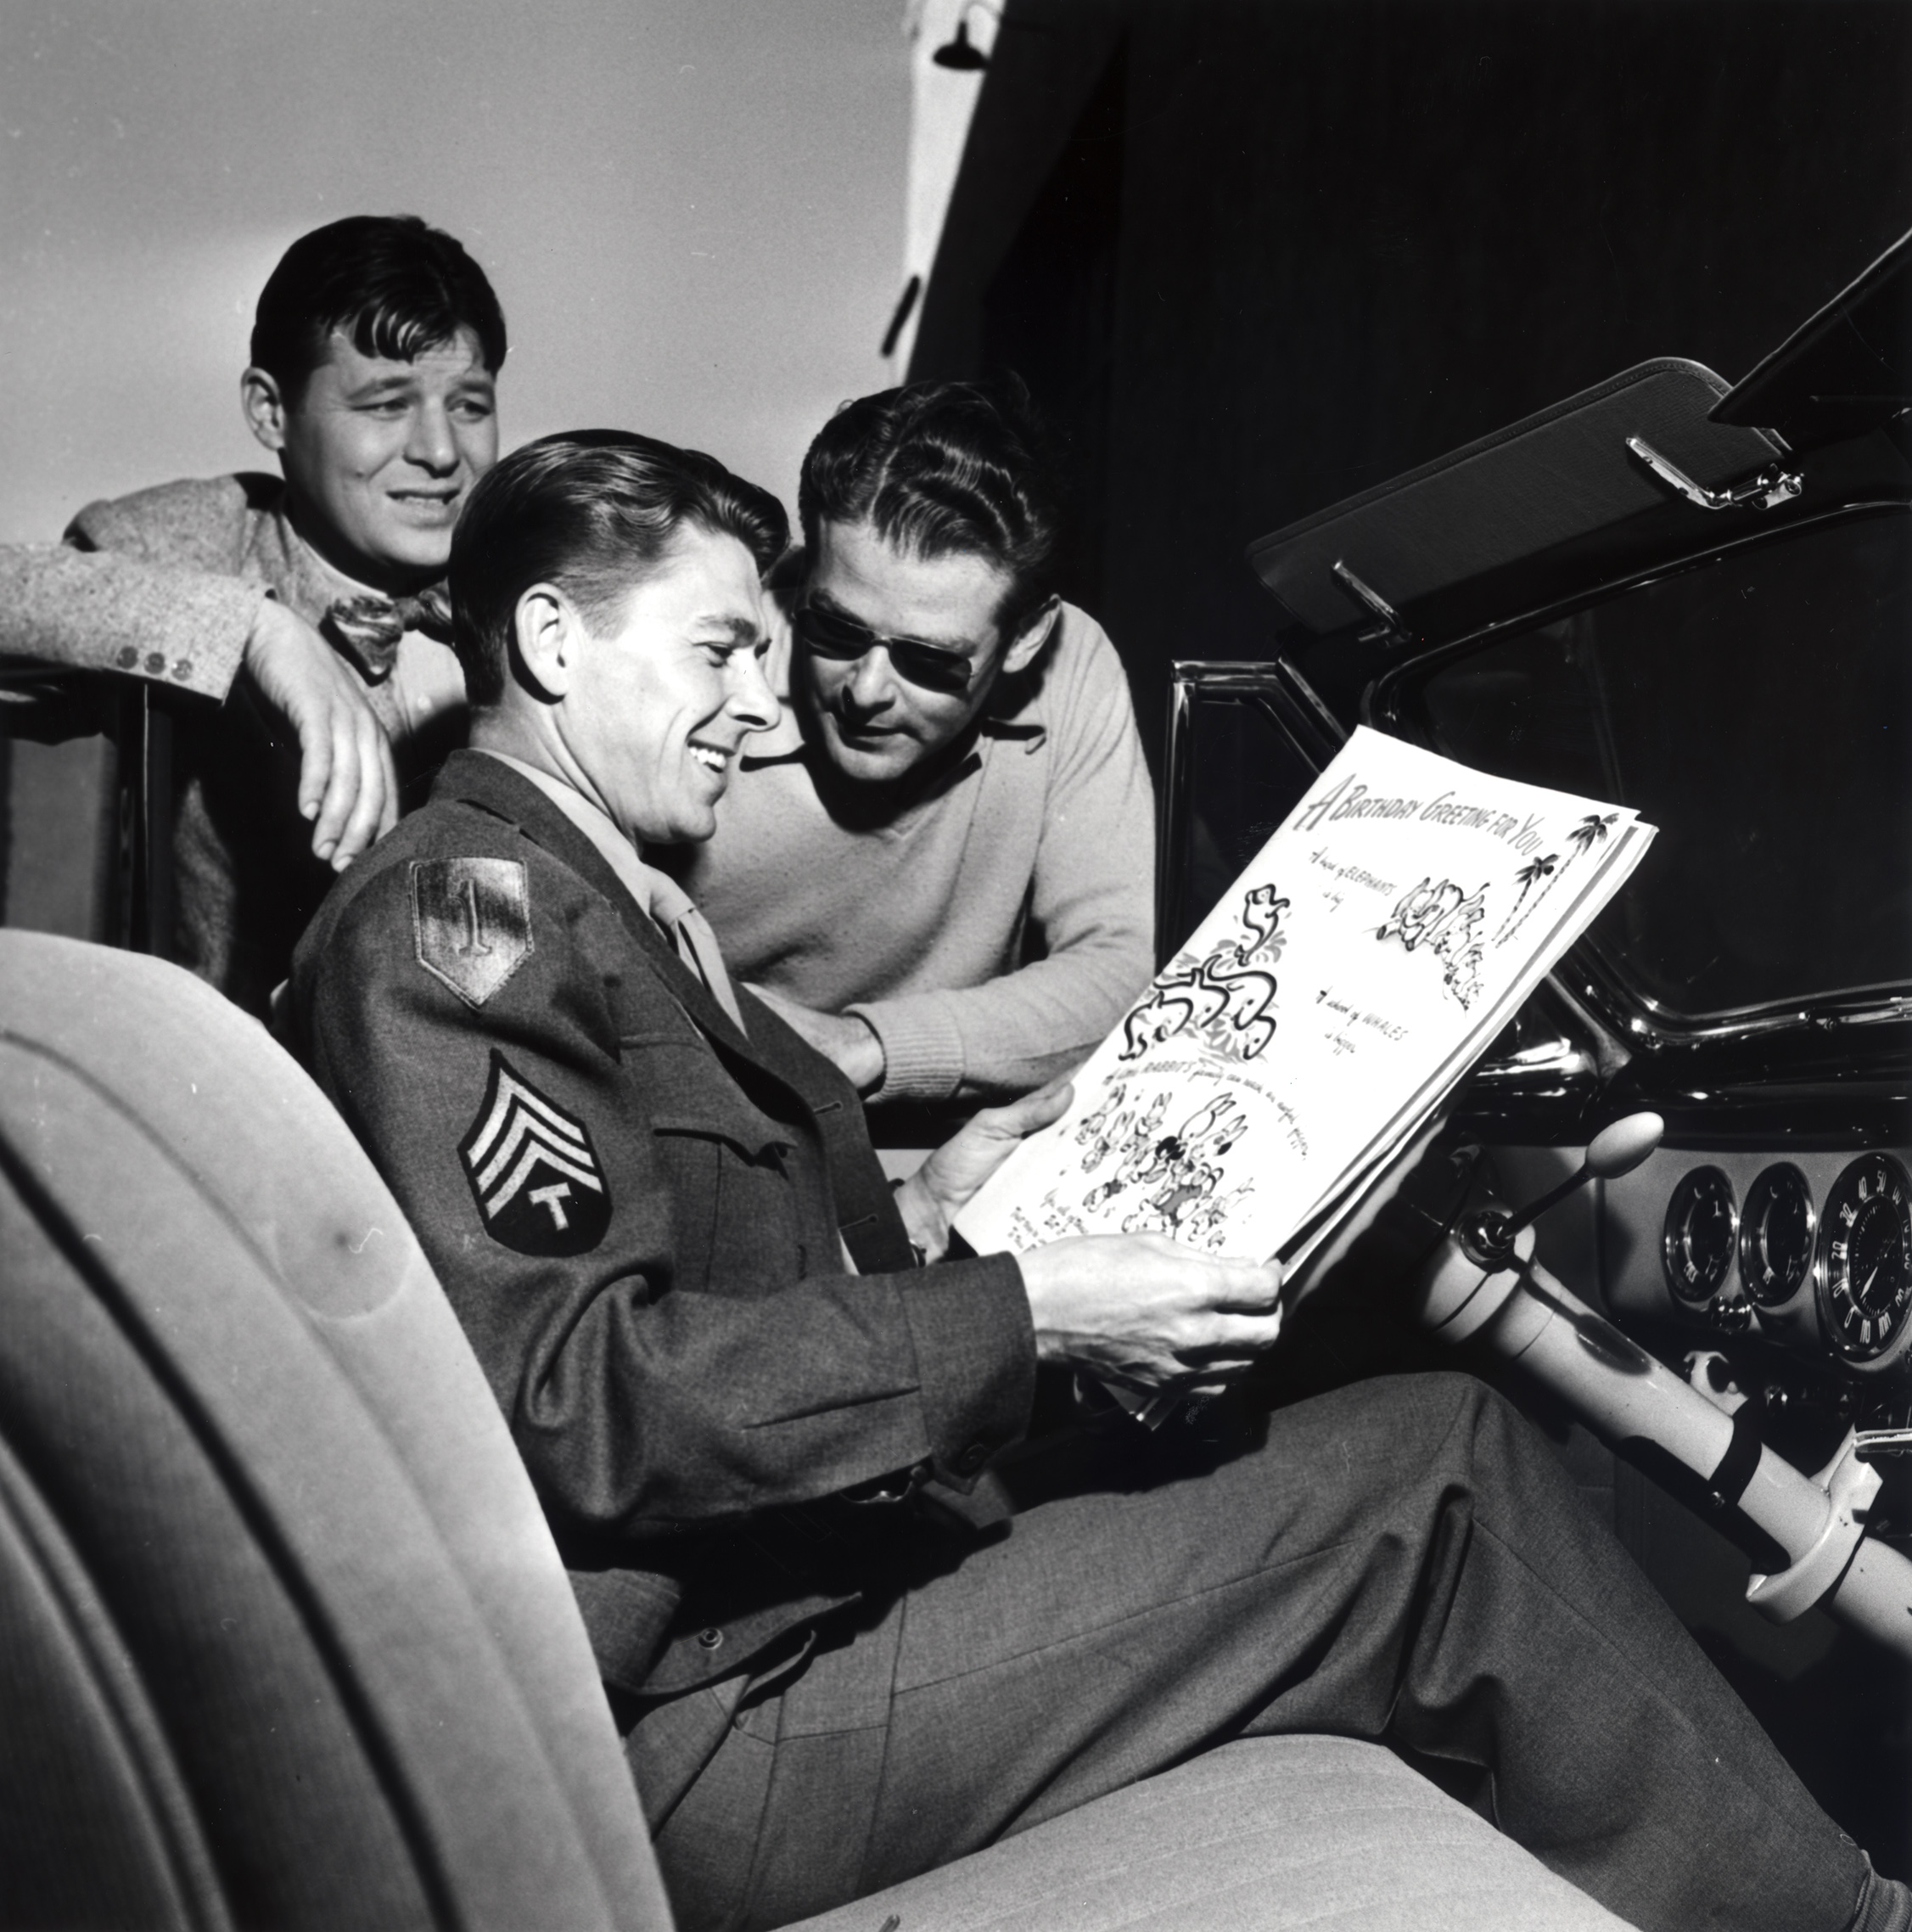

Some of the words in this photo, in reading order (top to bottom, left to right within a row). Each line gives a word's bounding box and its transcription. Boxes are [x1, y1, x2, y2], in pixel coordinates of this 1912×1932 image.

[1292, 773, 1357, 831] A
[1344, 866, 1398, 896] ELEPHANTS
[447, 879, 492, 955] 1
[1362, 1013, 1409, 1041] WHALES
[528, 1182, 572, 1230] T
